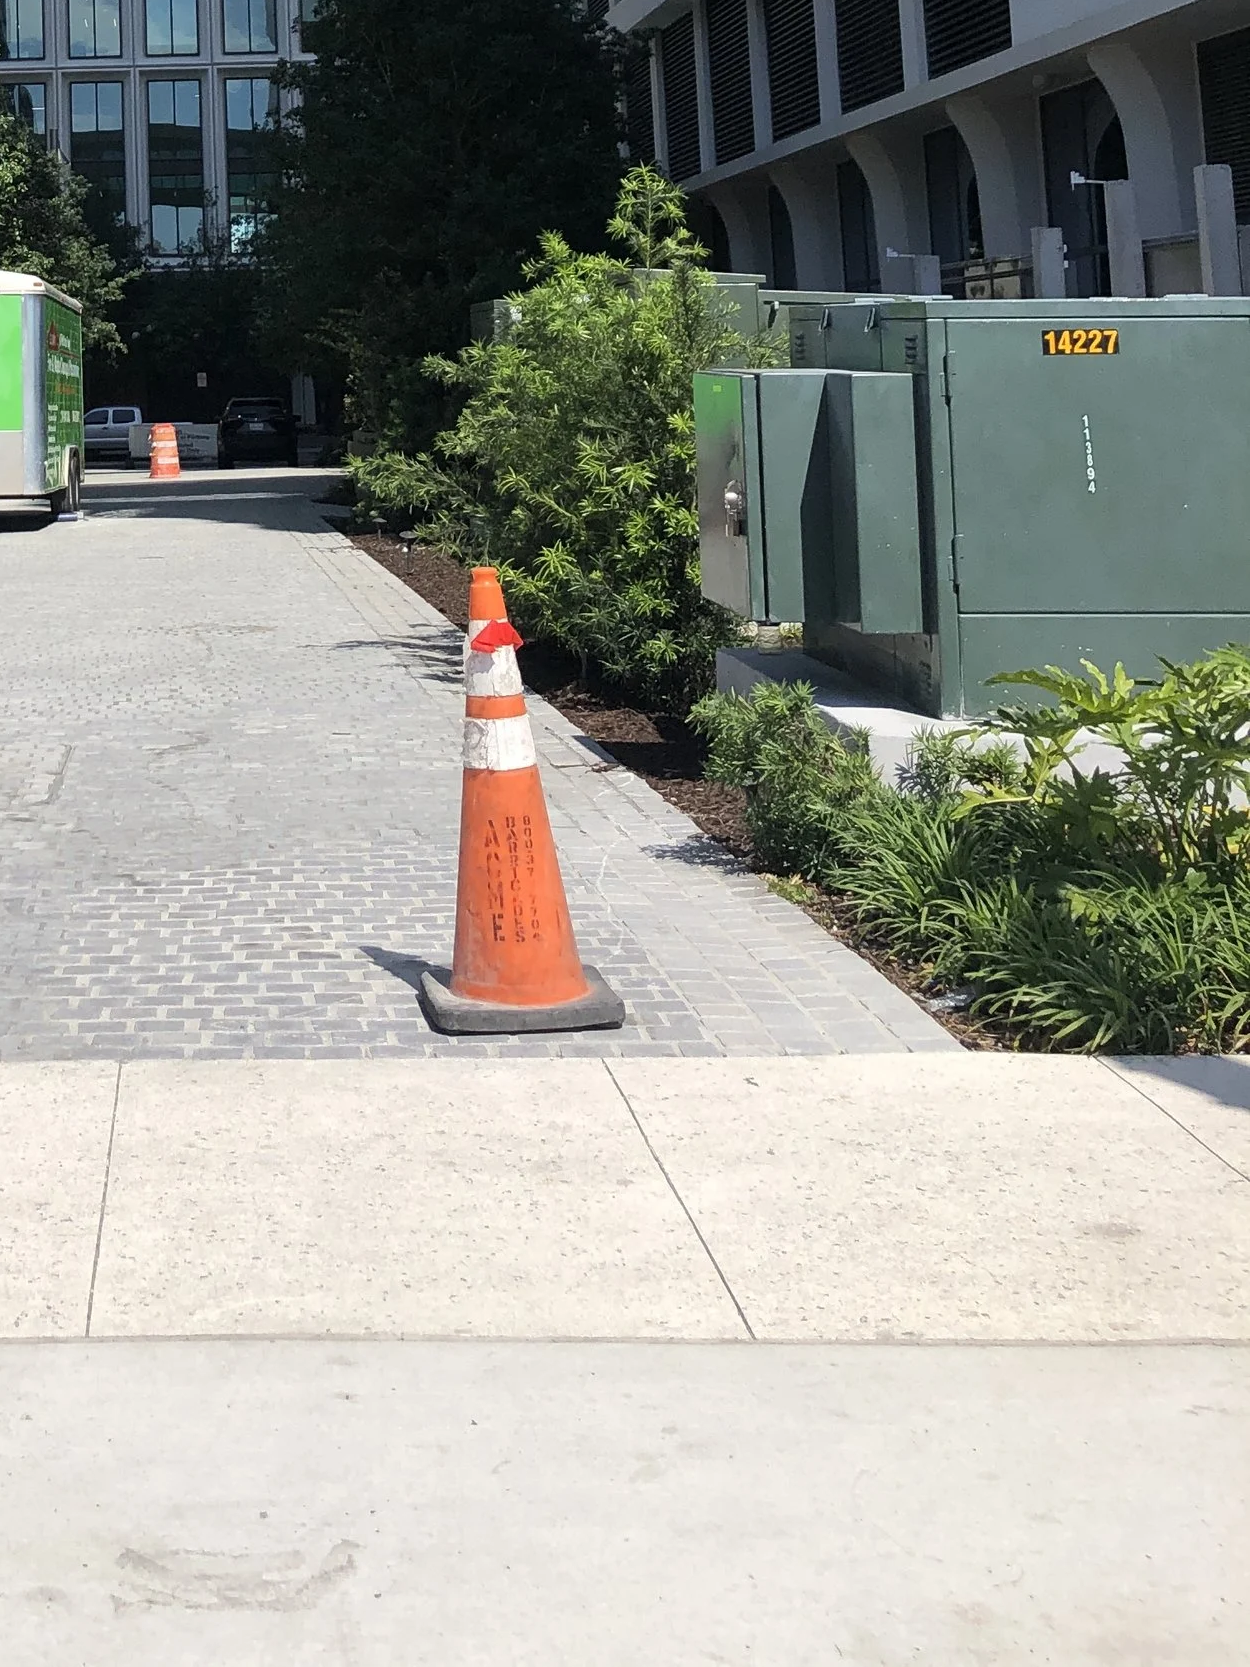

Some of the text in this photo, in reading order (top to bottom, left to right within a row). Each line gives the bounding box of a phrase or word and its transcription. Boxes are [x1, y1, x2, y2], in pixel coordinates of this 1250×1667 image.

[1044, 329, 1118, 354] 14227
[1081, 414, 1096, 494] 113894
[484, 819, 505, 942] ACME
